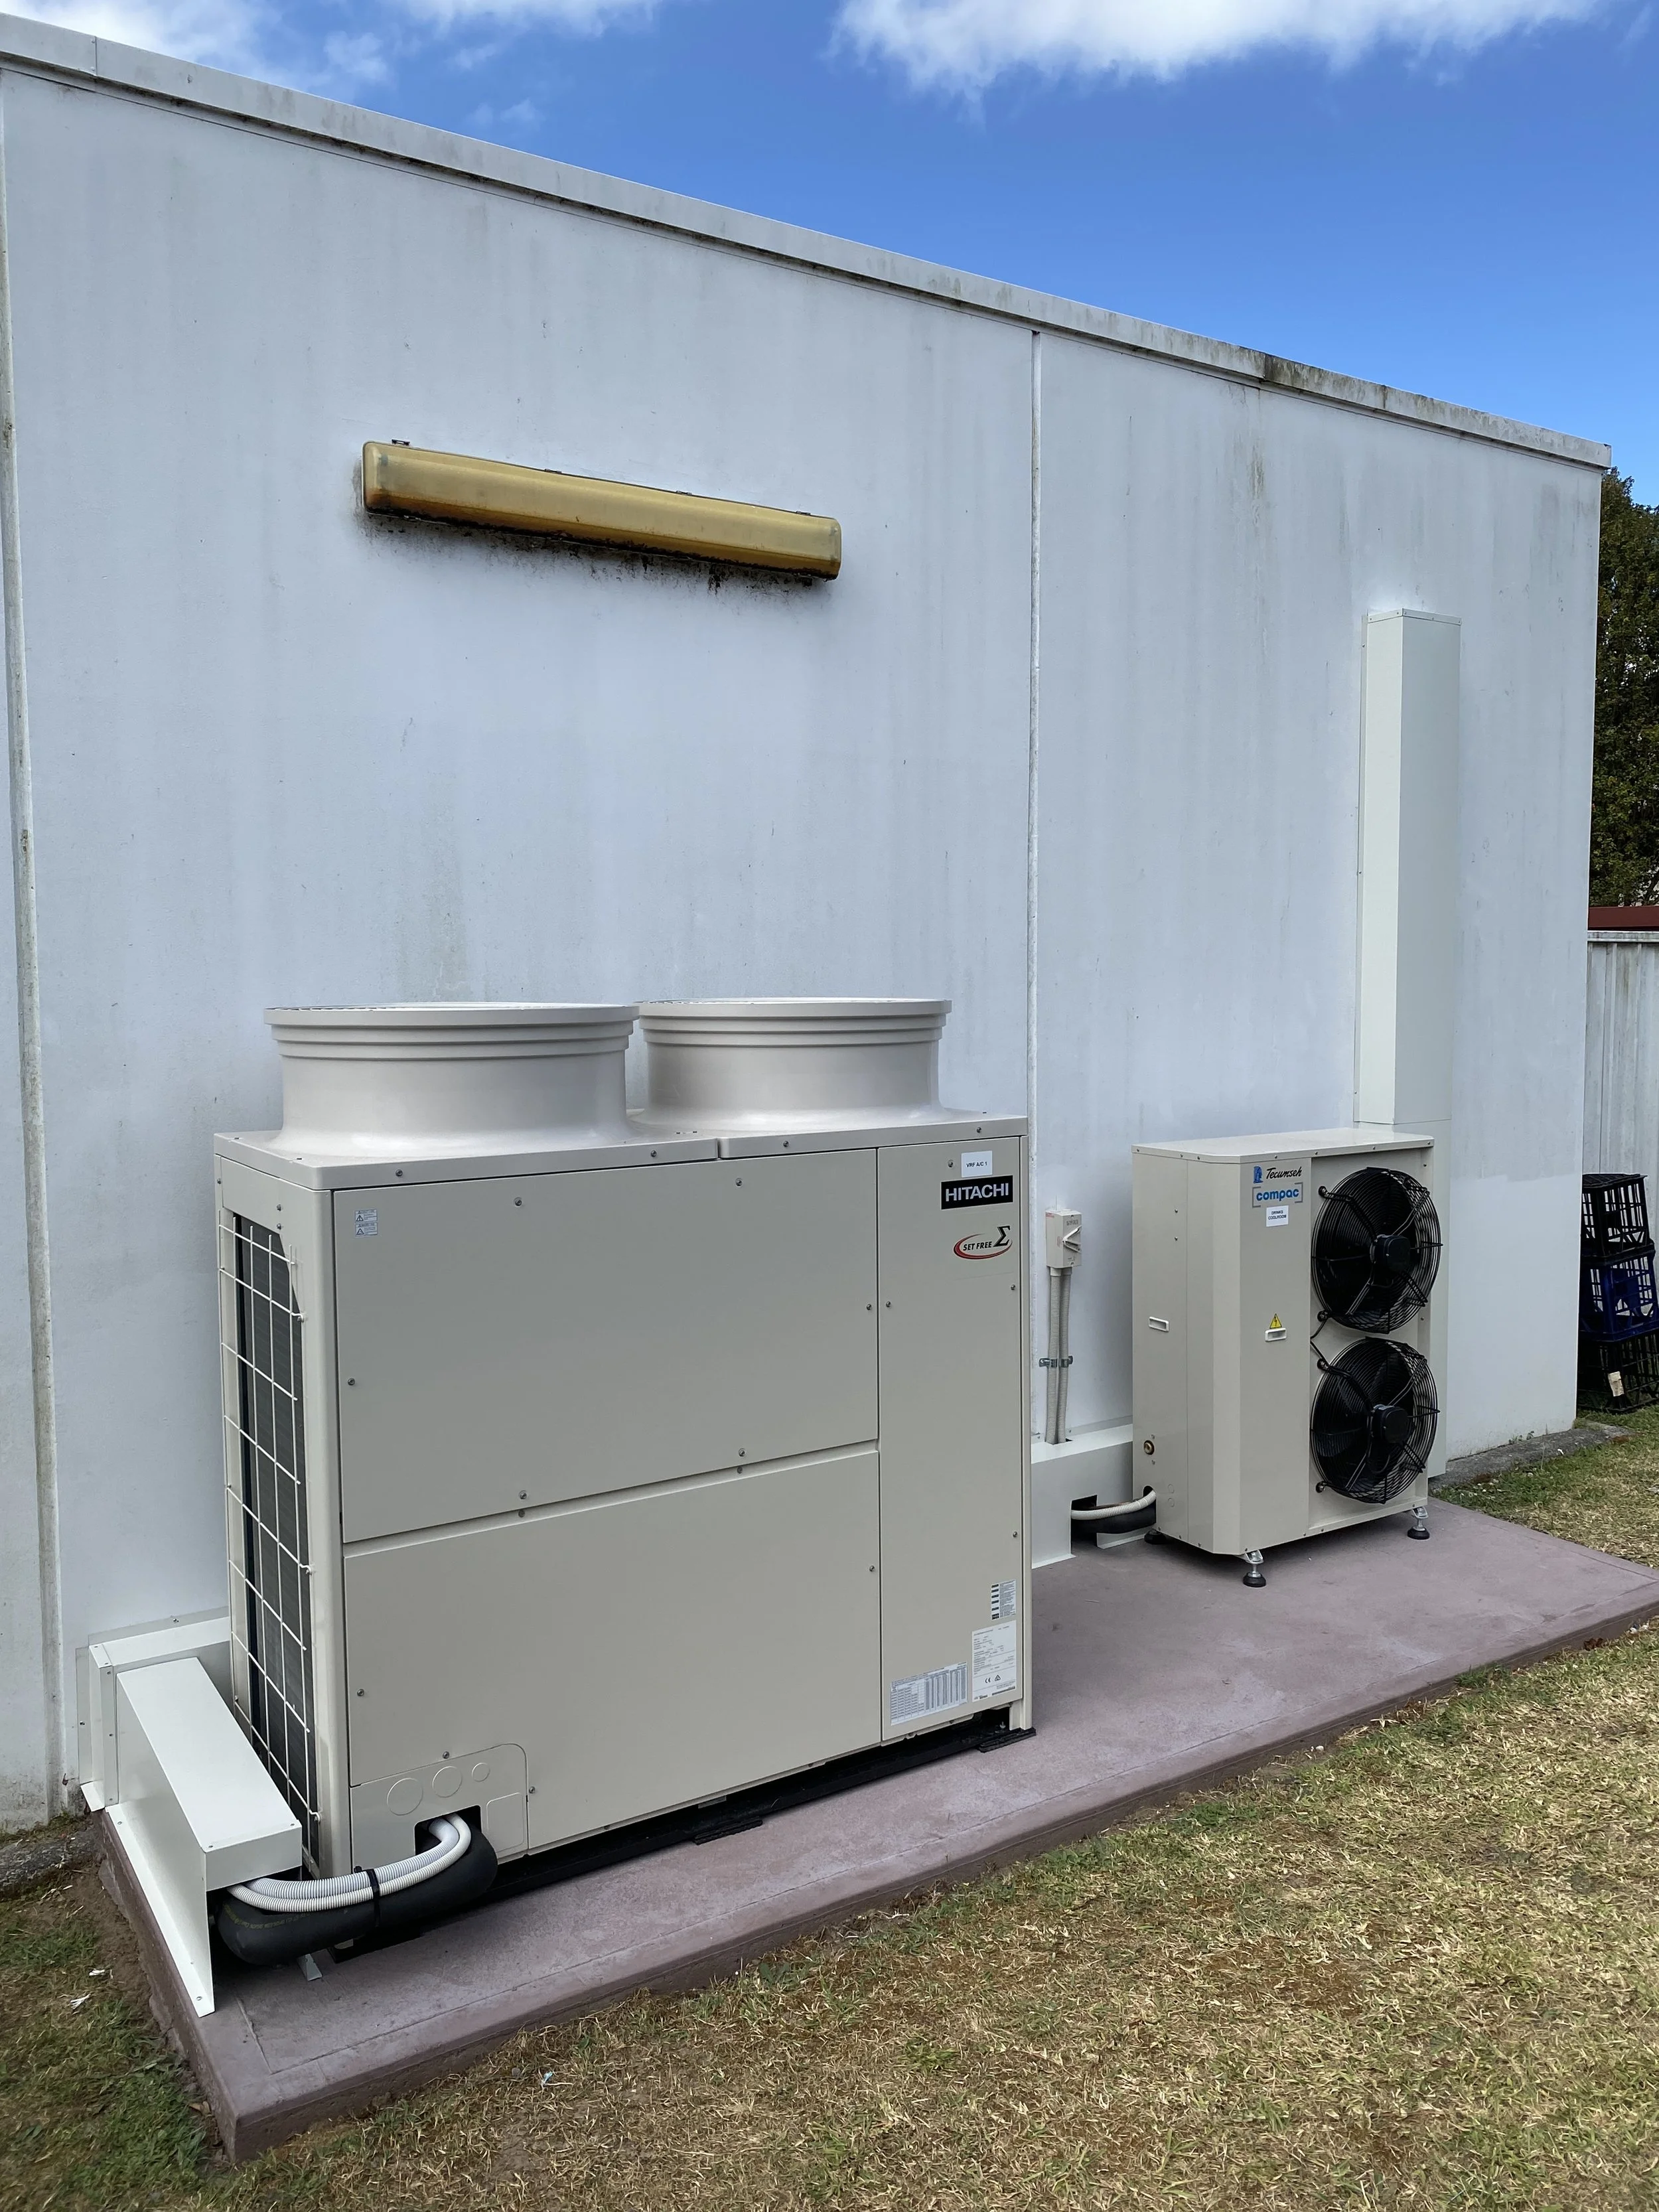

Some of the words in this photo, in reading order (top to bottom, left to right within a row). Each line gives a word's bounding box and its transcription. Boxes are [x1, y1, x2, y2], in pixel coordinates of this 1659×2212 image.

[1266, 1166, 1302, 1179] Tecumseh
[946, 1183, 1009, 1202] HITACHI
[1256, 1189, 1299, 1201] compac
[976, 1241, 992, 1250] FREE
